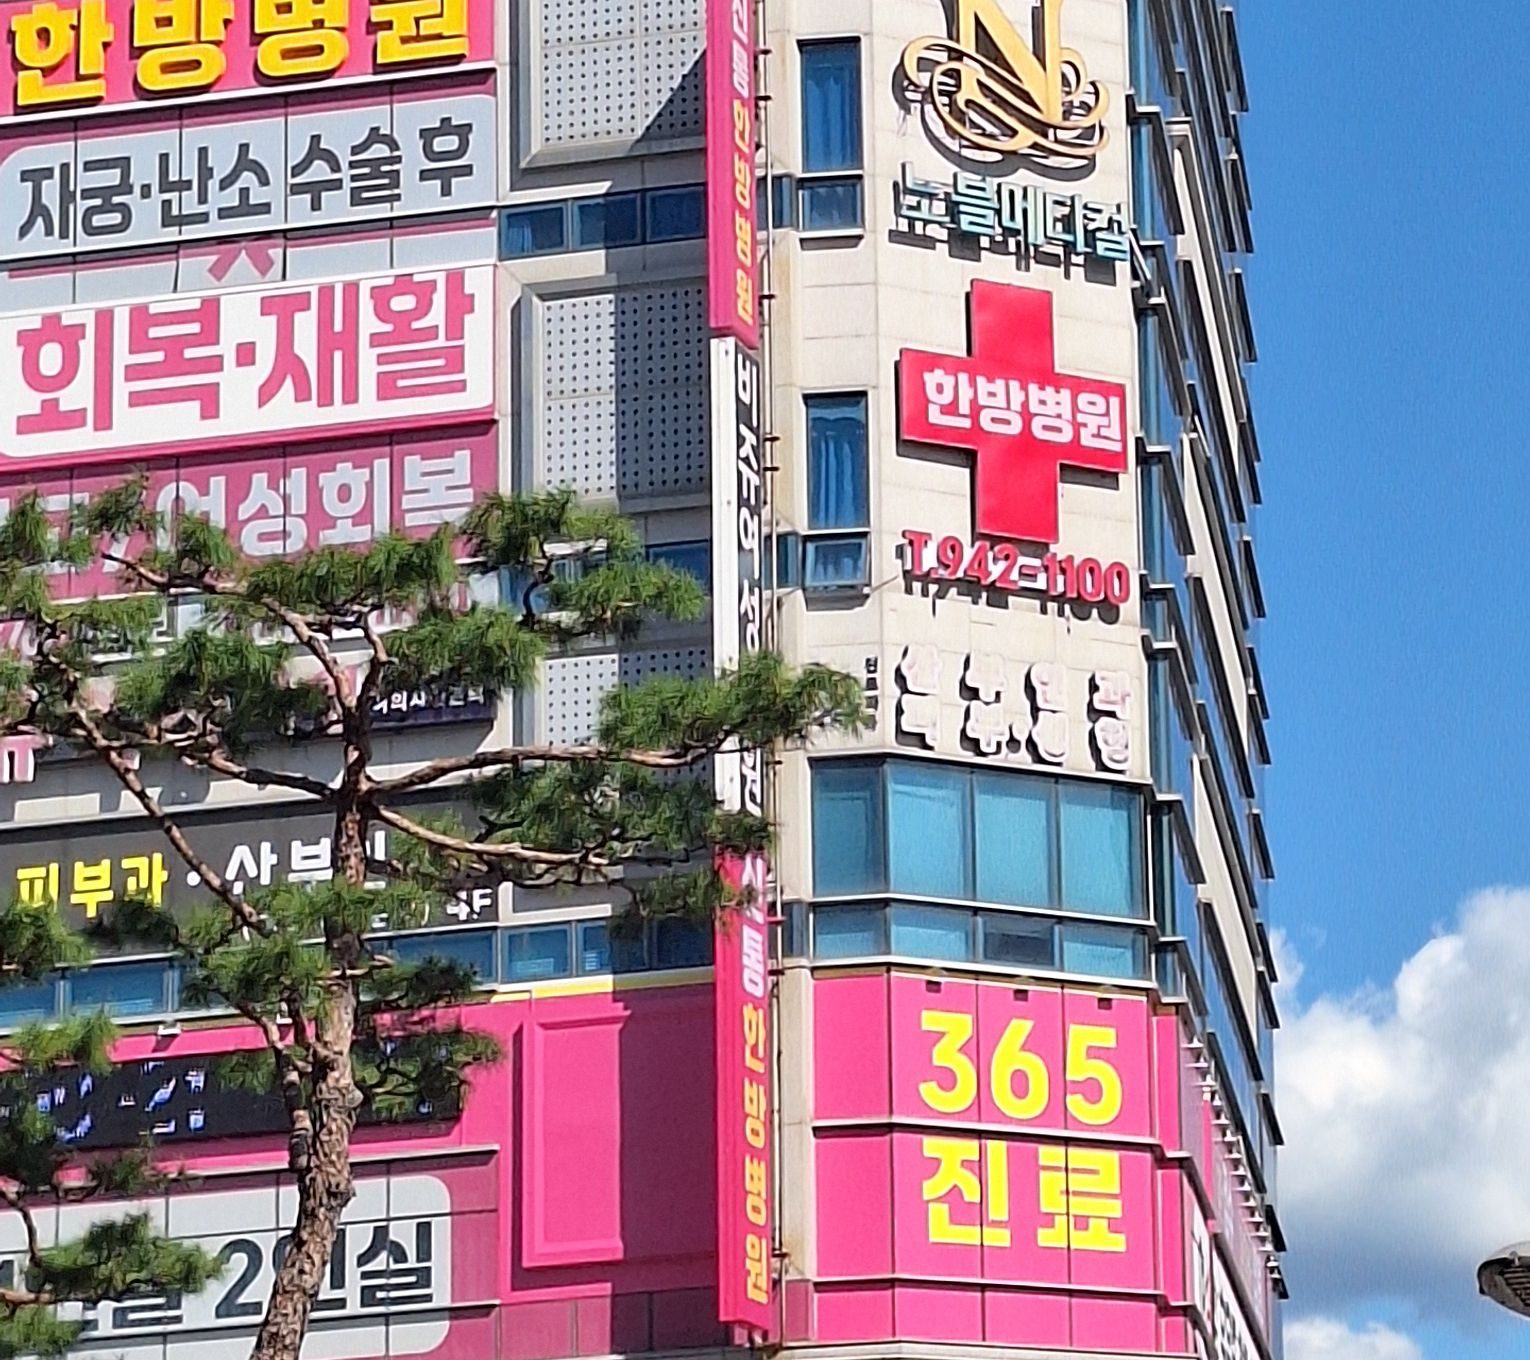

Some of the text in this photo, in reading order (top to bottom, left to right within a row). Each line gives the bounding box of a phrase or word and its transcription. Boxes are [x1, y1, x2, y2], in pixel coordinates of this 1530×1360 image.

[899, 163, 1132, 262] 노블메디컬
[16, 267, 476, 436] 회복·재활
[923, 368, 1124, 453] 한방병원
[737, 352, 764, 817] 비쥬여성원
[902, 530, 1131, 606] T.942-1100
[918, 1009, 1123, 1126] 365
[922, 1137, 1127, 1253] 진료
